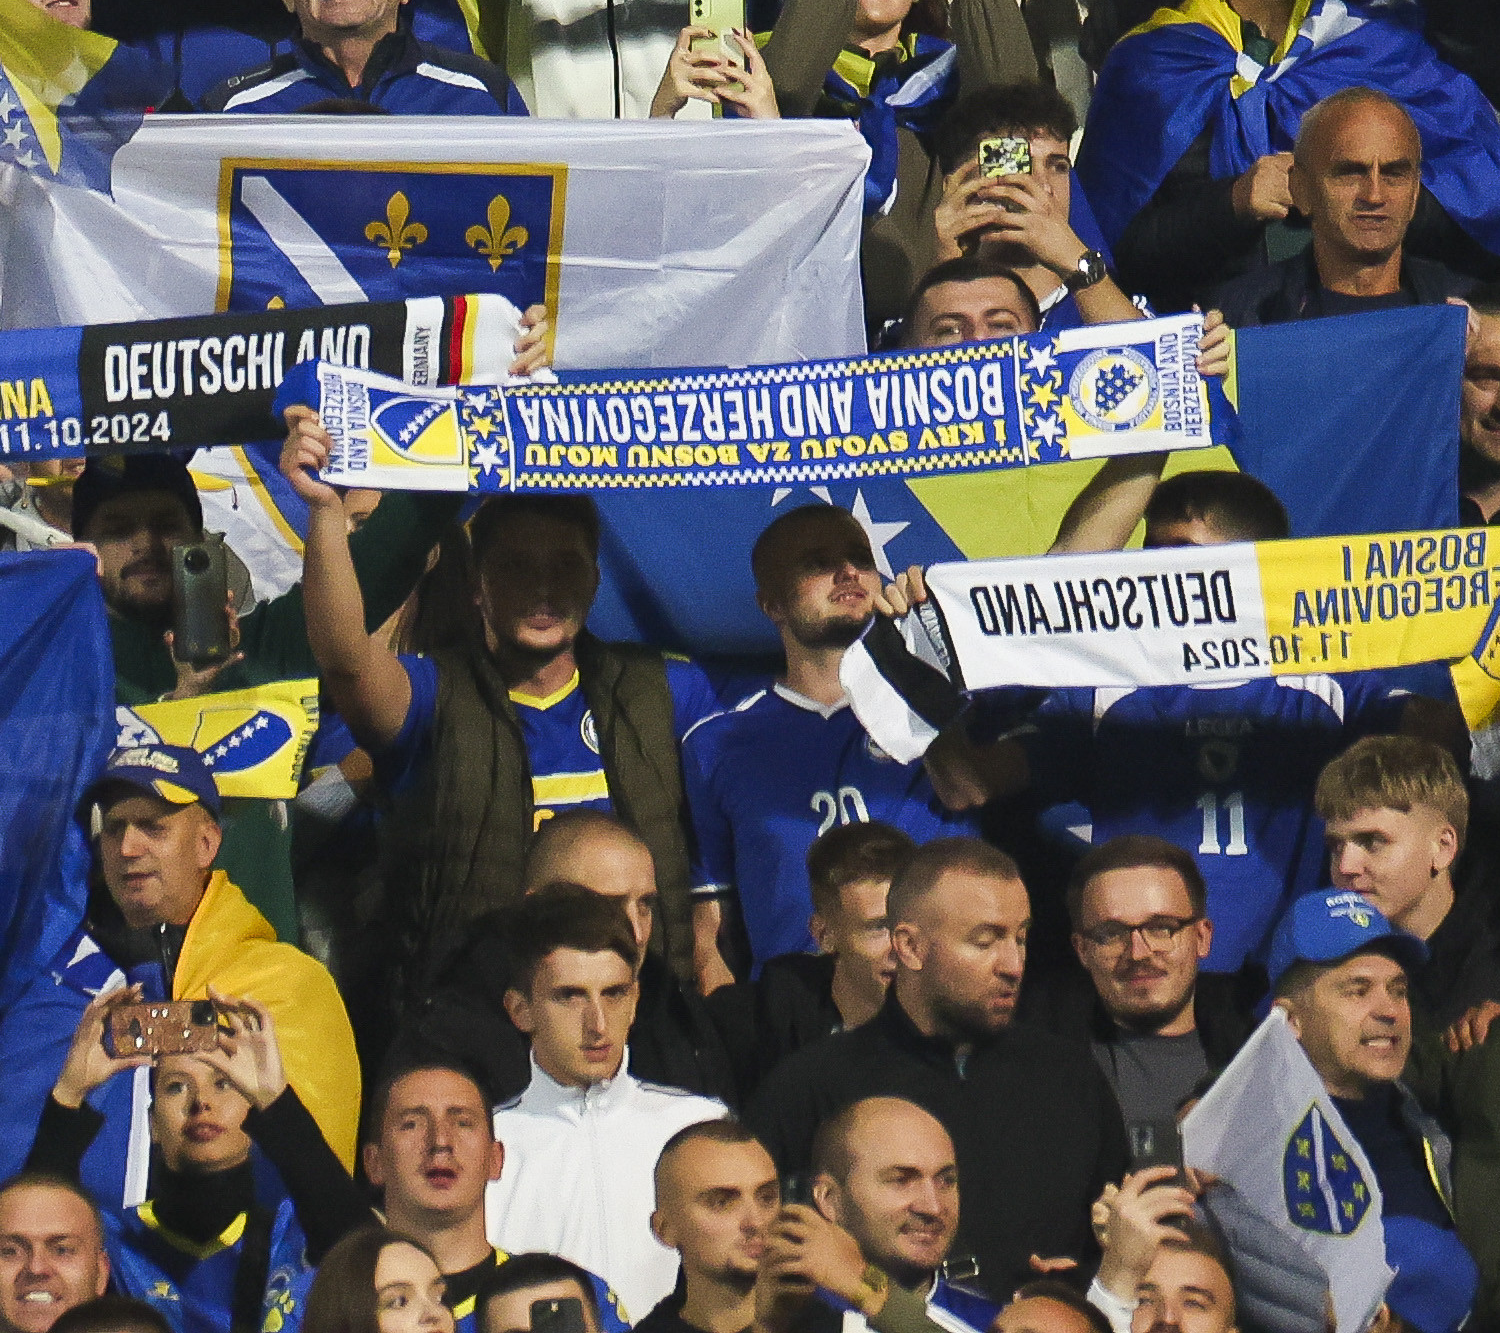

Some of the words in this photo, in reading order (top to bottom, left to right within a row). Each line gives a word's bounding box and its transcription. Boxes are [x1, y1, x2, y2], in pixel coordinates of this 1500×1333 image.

[517, 388, 774, 444] HERZEGOVINA
[780, 380, 854, 437] AND
[865, 362, 1004, 429] BOSNIA
[525, 444, 617, 467] MOJU
[628, 445, 740, 467] BOSNU
[1198, 792, 1249, 857] 11
